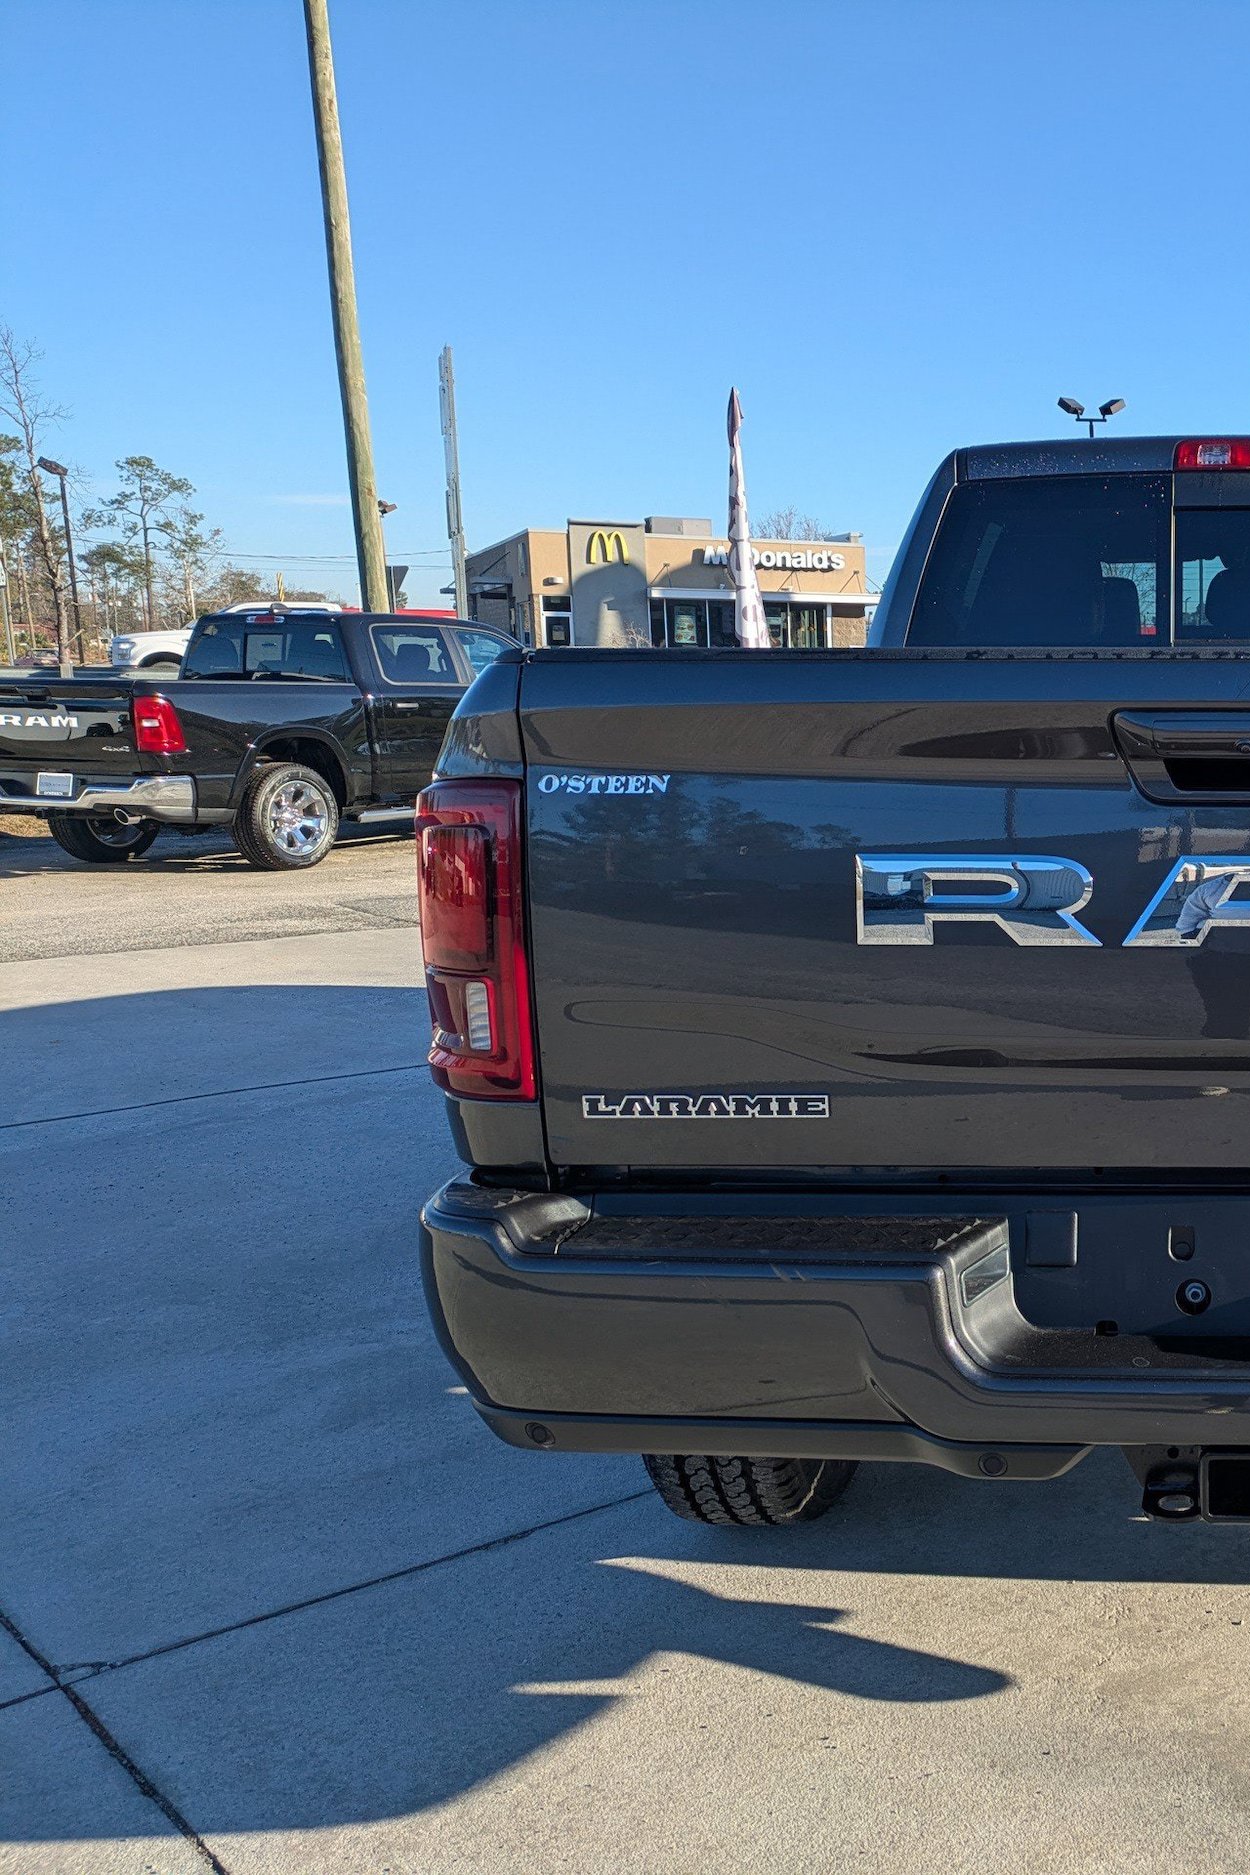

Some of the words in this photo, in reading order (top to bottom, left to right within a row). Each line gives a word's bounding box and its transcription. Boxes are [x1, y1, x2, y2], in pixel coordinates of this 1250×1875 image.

[703, 545, 846, 570] MDonald's
[0, 714, 78, 728] RAM
[537, 773, 671, 794] O'STEEN
[582, 1094, 830, 1118] LARAMIE
